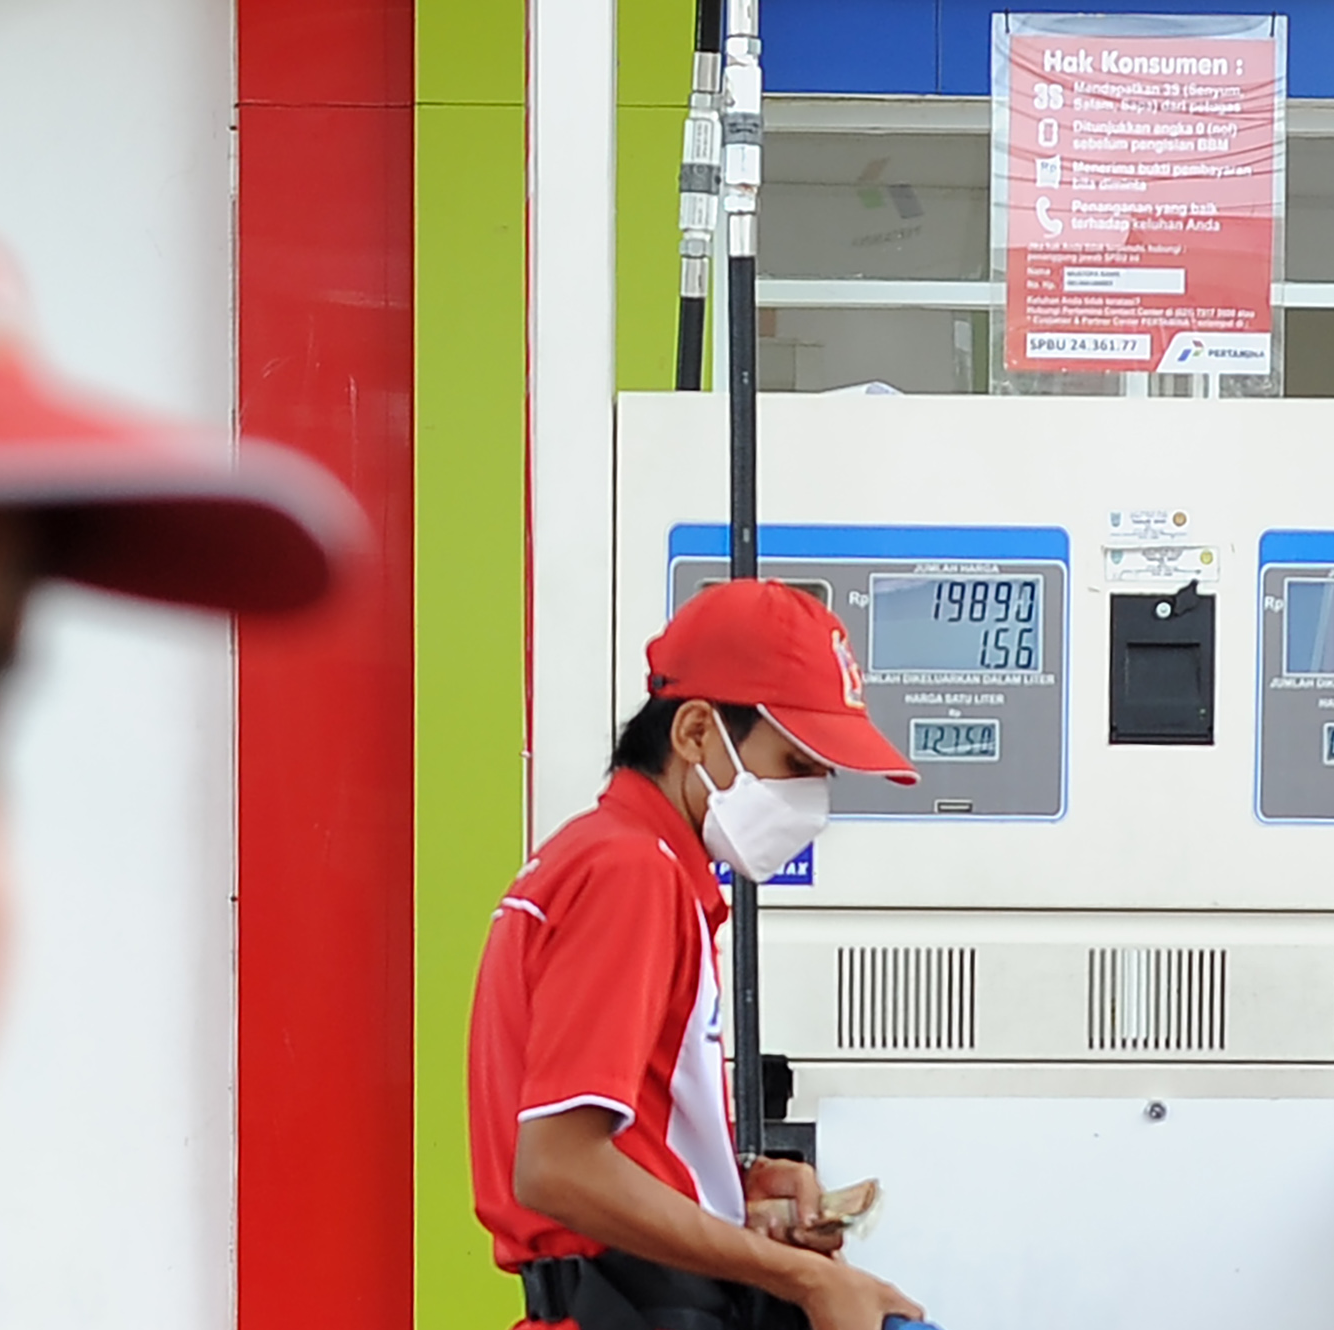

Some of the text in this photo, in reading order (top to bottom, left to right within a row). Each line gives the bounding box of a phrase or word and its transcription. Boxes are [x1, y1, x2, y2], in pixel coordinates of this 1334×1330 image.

[1044, 49, 1094, 73] Hak
[1101, 50, 1228, 75] Konsumen
[1033, 82, 1064, 110] 3S
[1073, 119, 1237, 138] Ditunjukkan angka 0 (nol)
[1073, 137, 1229, 154] sebelum pengisian BBM
[1073, 161, 1135, 174] Menerima
[1138, 163, 1171, 175] bukti
[1071, 199, 1218, 218] Penanganan yang baik
[1071, 216, 1221, 232] terhadap keluhan Anda
[1030, 338, 1137, 351] SPBU 24.361.77
[959, 563, 1000, 574] HARGA
[848, 591, 870, 608] Rp
[1264, 595, 1284, 613] Rp
[862, 674, 901, 684] UMLAH
[983, 674, 1022, 685] DALAM
[1024, 674, 1055, 685] LITER
[1270, 678, 1314, 689] JUMLAH
[905, 693, 1005, 704] HARGA SATU LITER
